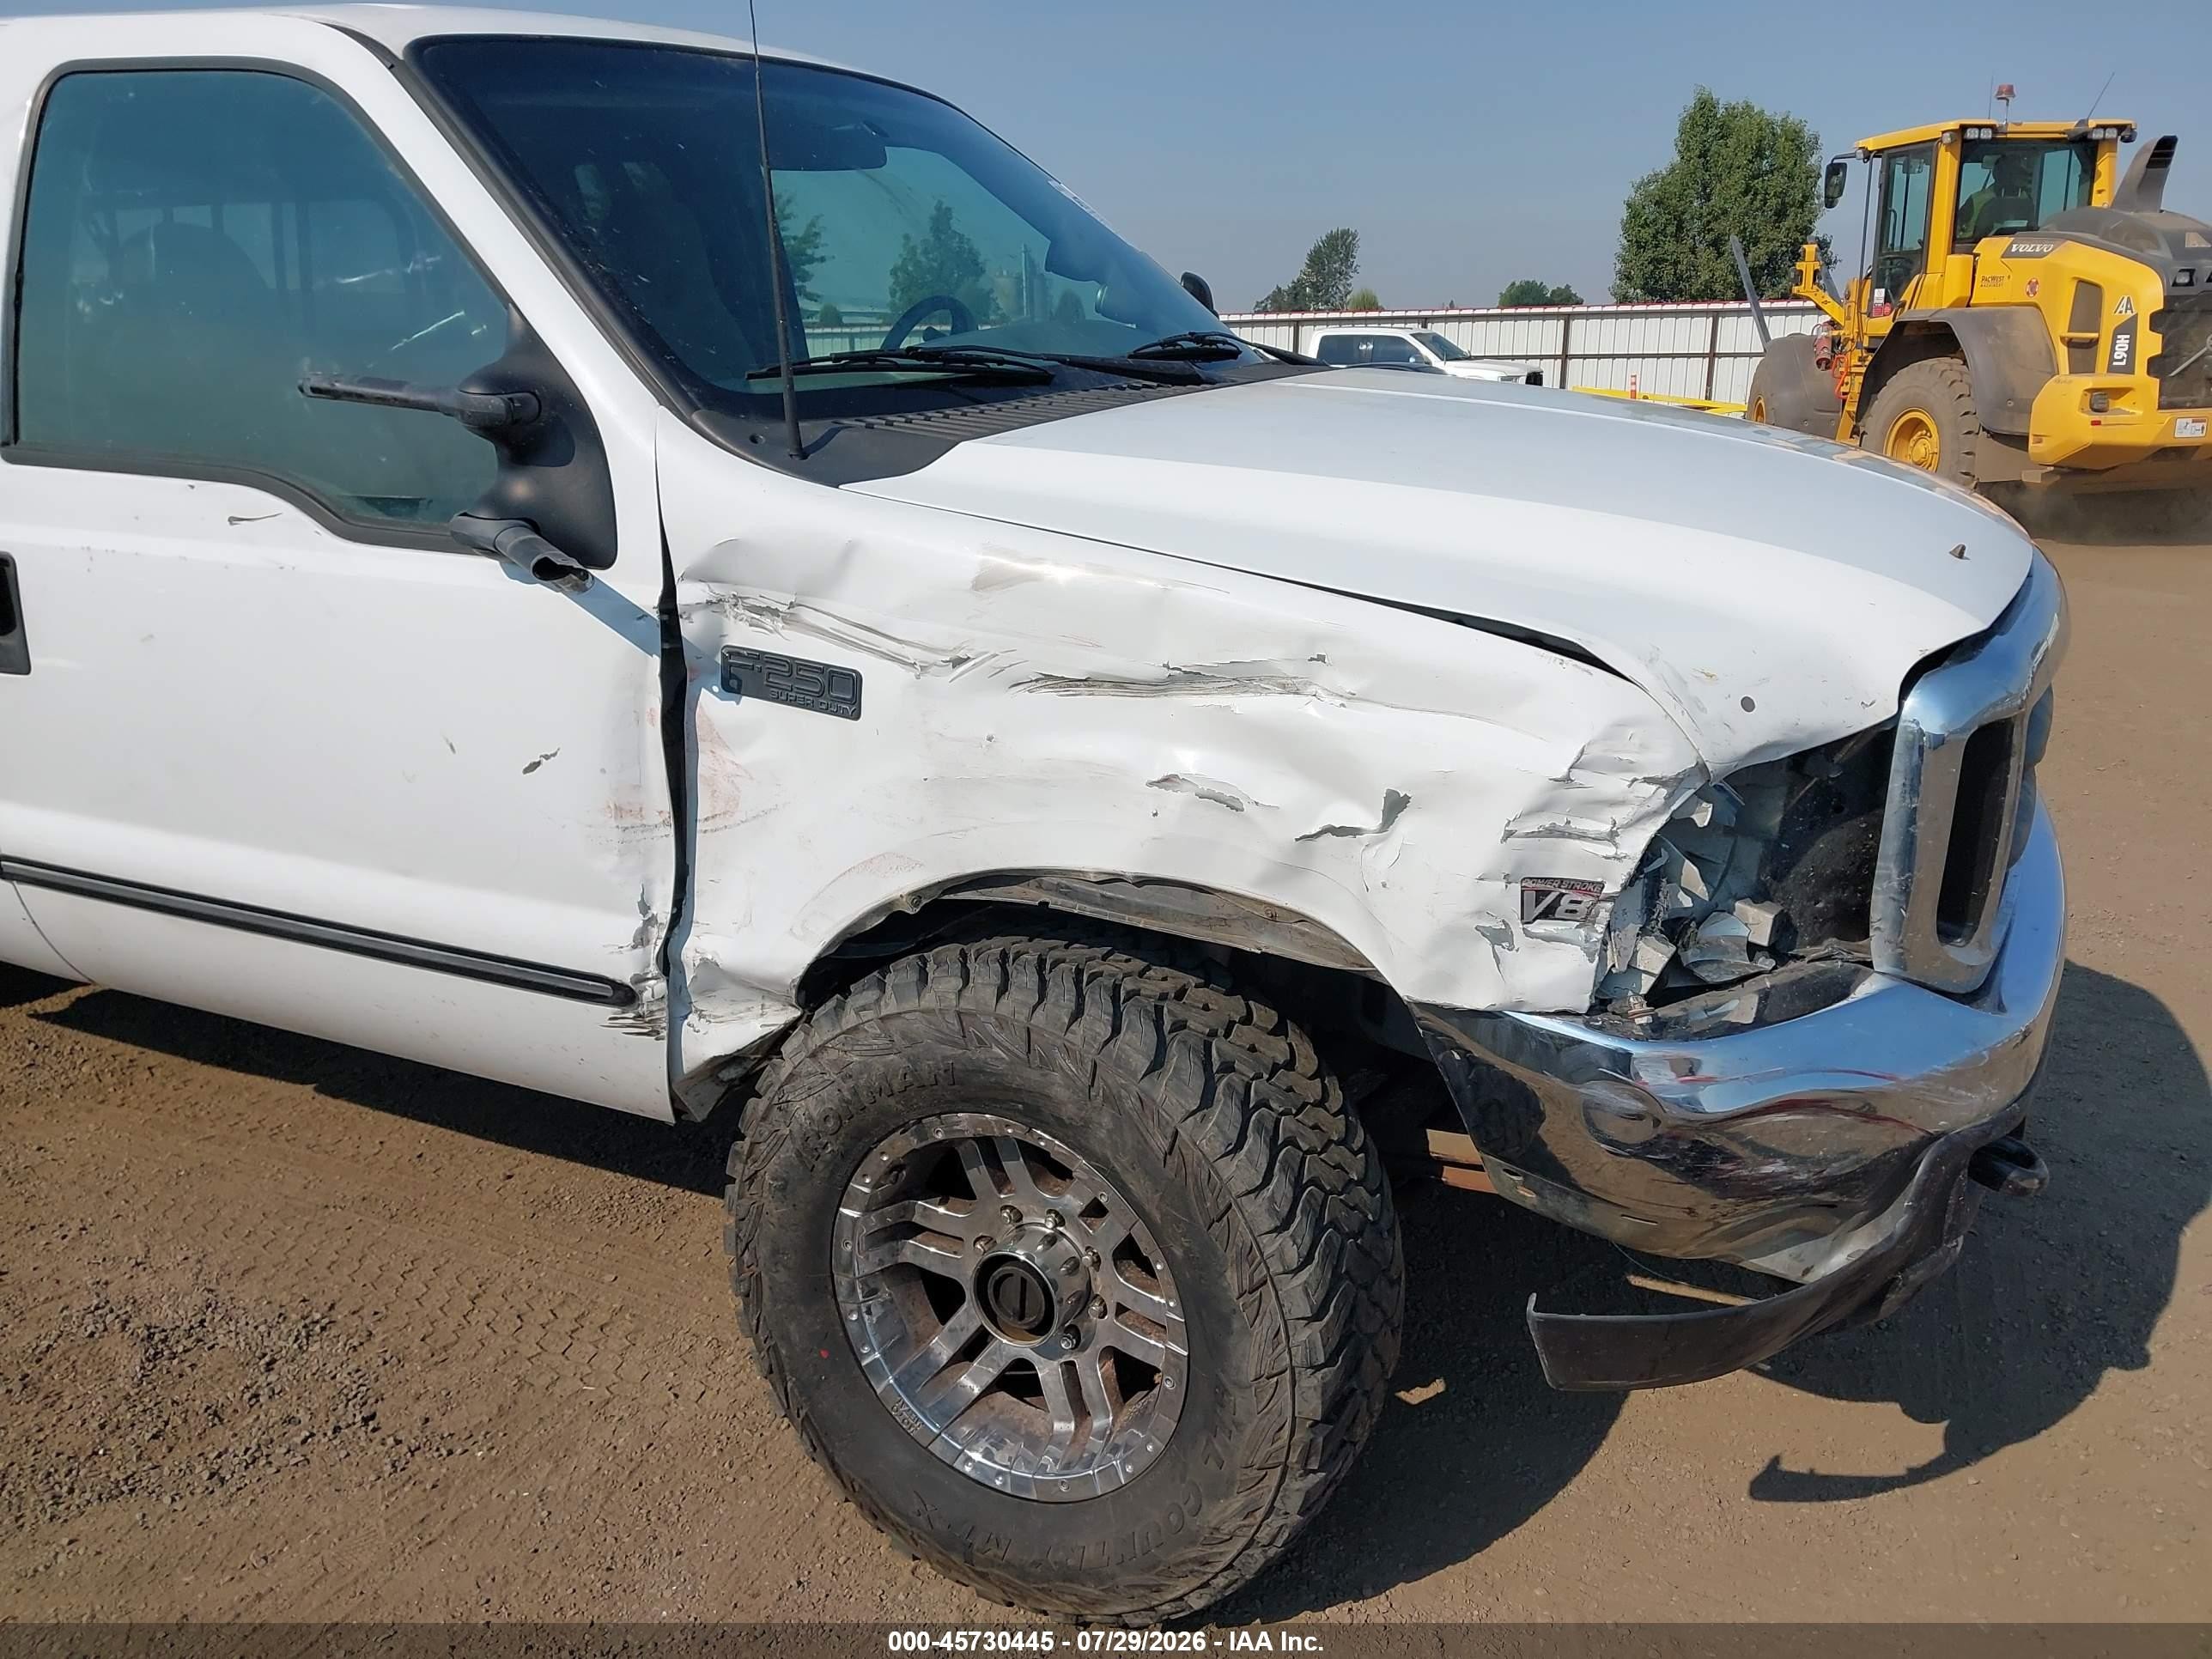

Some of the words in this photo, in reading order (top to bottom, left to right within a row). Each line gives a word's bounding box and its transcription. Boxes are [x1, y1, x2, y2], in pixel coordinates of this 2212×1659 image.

[2011, 244, 2054, 252] VOLVO
[2112, 334, 2130, 366] L90H
[769, 690, 815, 708] SUPER
[818, 699, 857, 717] DUTY
[1522, 878, 1561, 889] POWER
[1562, 880, 1603, 893] STROKE
[1523, 890, 1590, 922] V8
